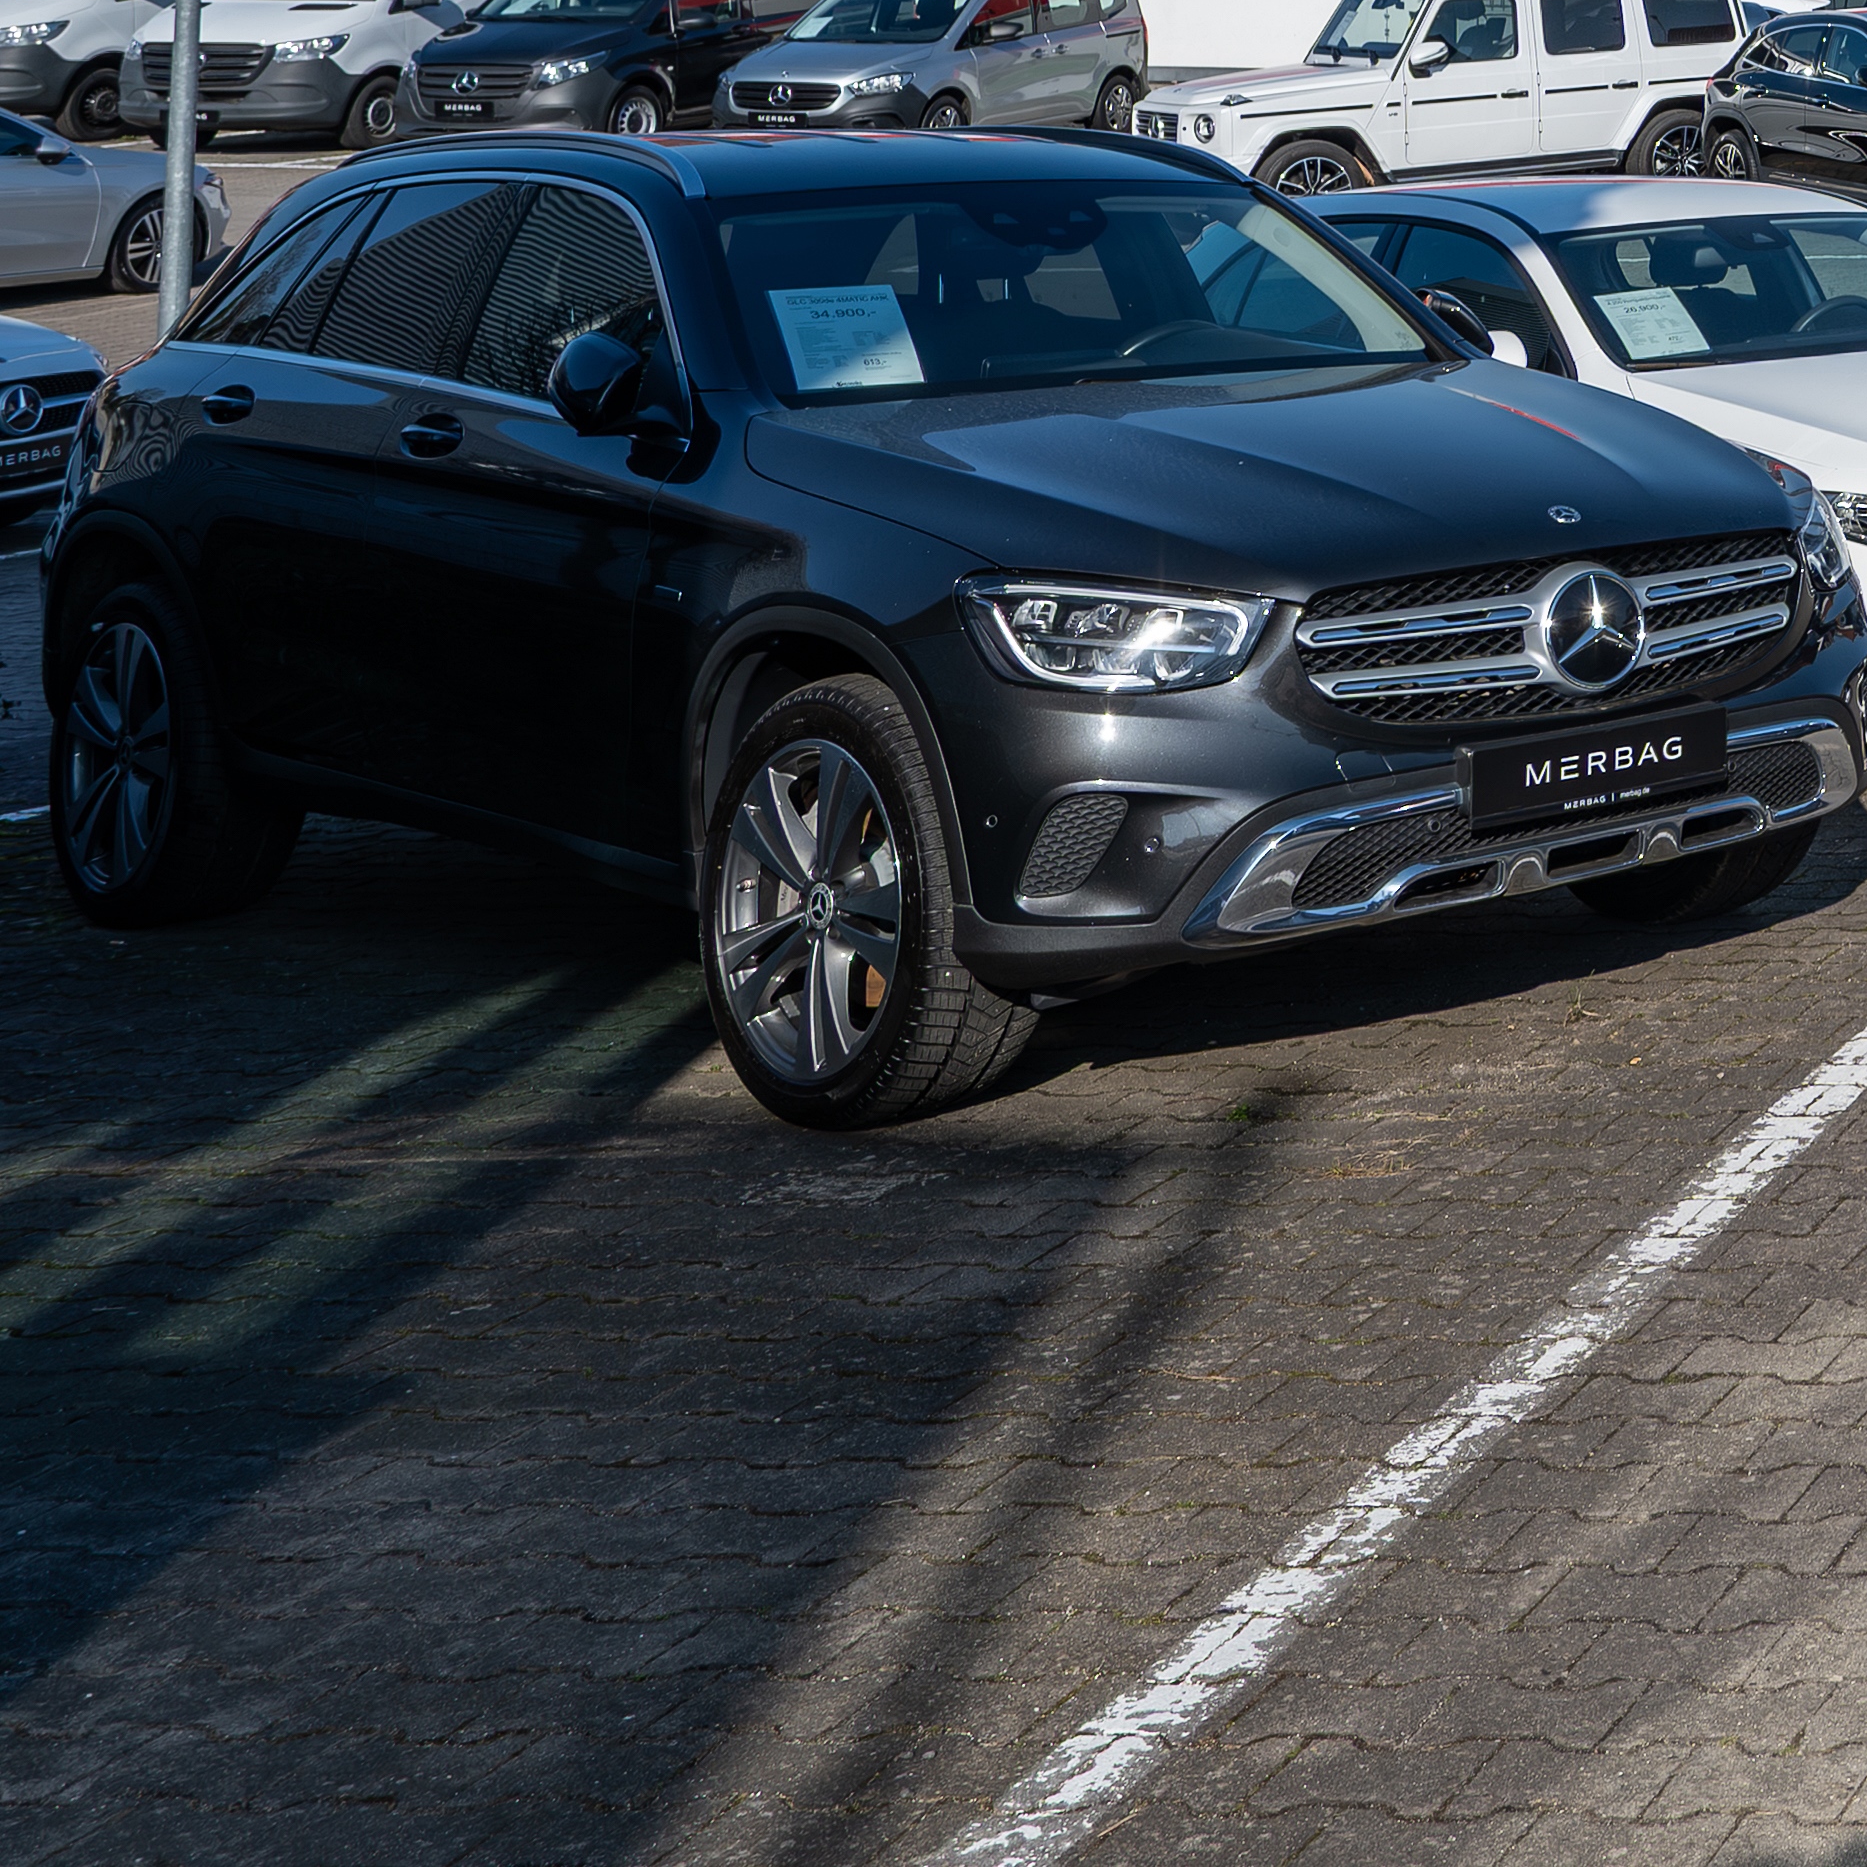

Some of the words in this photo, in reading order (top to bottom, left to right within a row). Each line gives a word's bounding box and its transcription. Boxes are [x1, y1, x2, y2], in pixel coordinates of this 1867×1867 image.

[444, 103, 483, 112] MERBAG
[757, 114, 796, 123] MERBAG
[810, 307, 877, 320] 34.900,-
[1524, 735, 1684, 788] MERBAG
[1563, 794, 1607, 810] MERBAG
[1619, 786, 1651, 800] merbag.de
